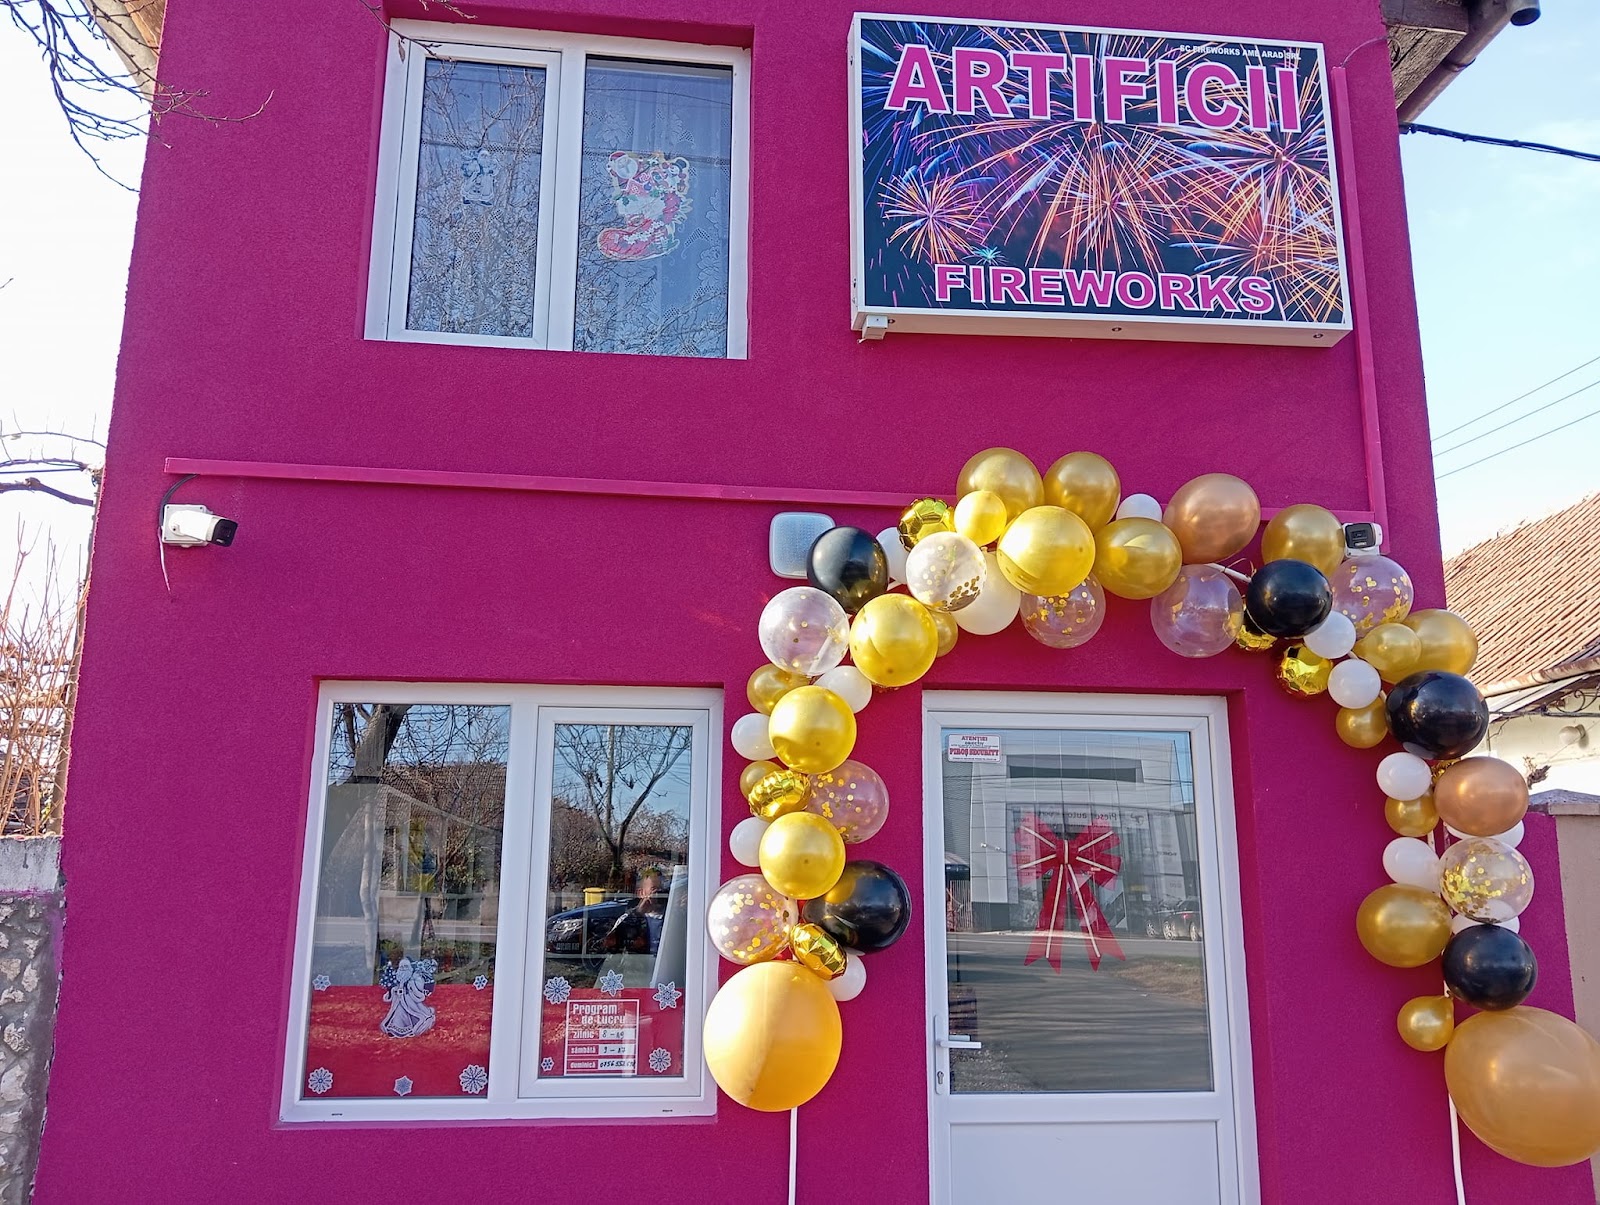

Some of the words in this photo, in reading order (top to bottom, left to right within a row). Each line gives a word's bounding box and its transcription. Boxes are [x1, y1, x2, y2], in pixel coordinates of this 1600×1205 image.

[1180, 44, 1191, 52] SC
[1192, 45, 1240, 56] FIREWORKS
[1261, 50, 1284, 59] ARAD
[1285, 52, 1301, 60] SRL
[884, 43, 1302, 134] ARTIFICII
[933, 263, 1275, 314] FIREWORKS
[573, 1004, 617, 1015] Program
[581, 1015, 594, 1024] de
